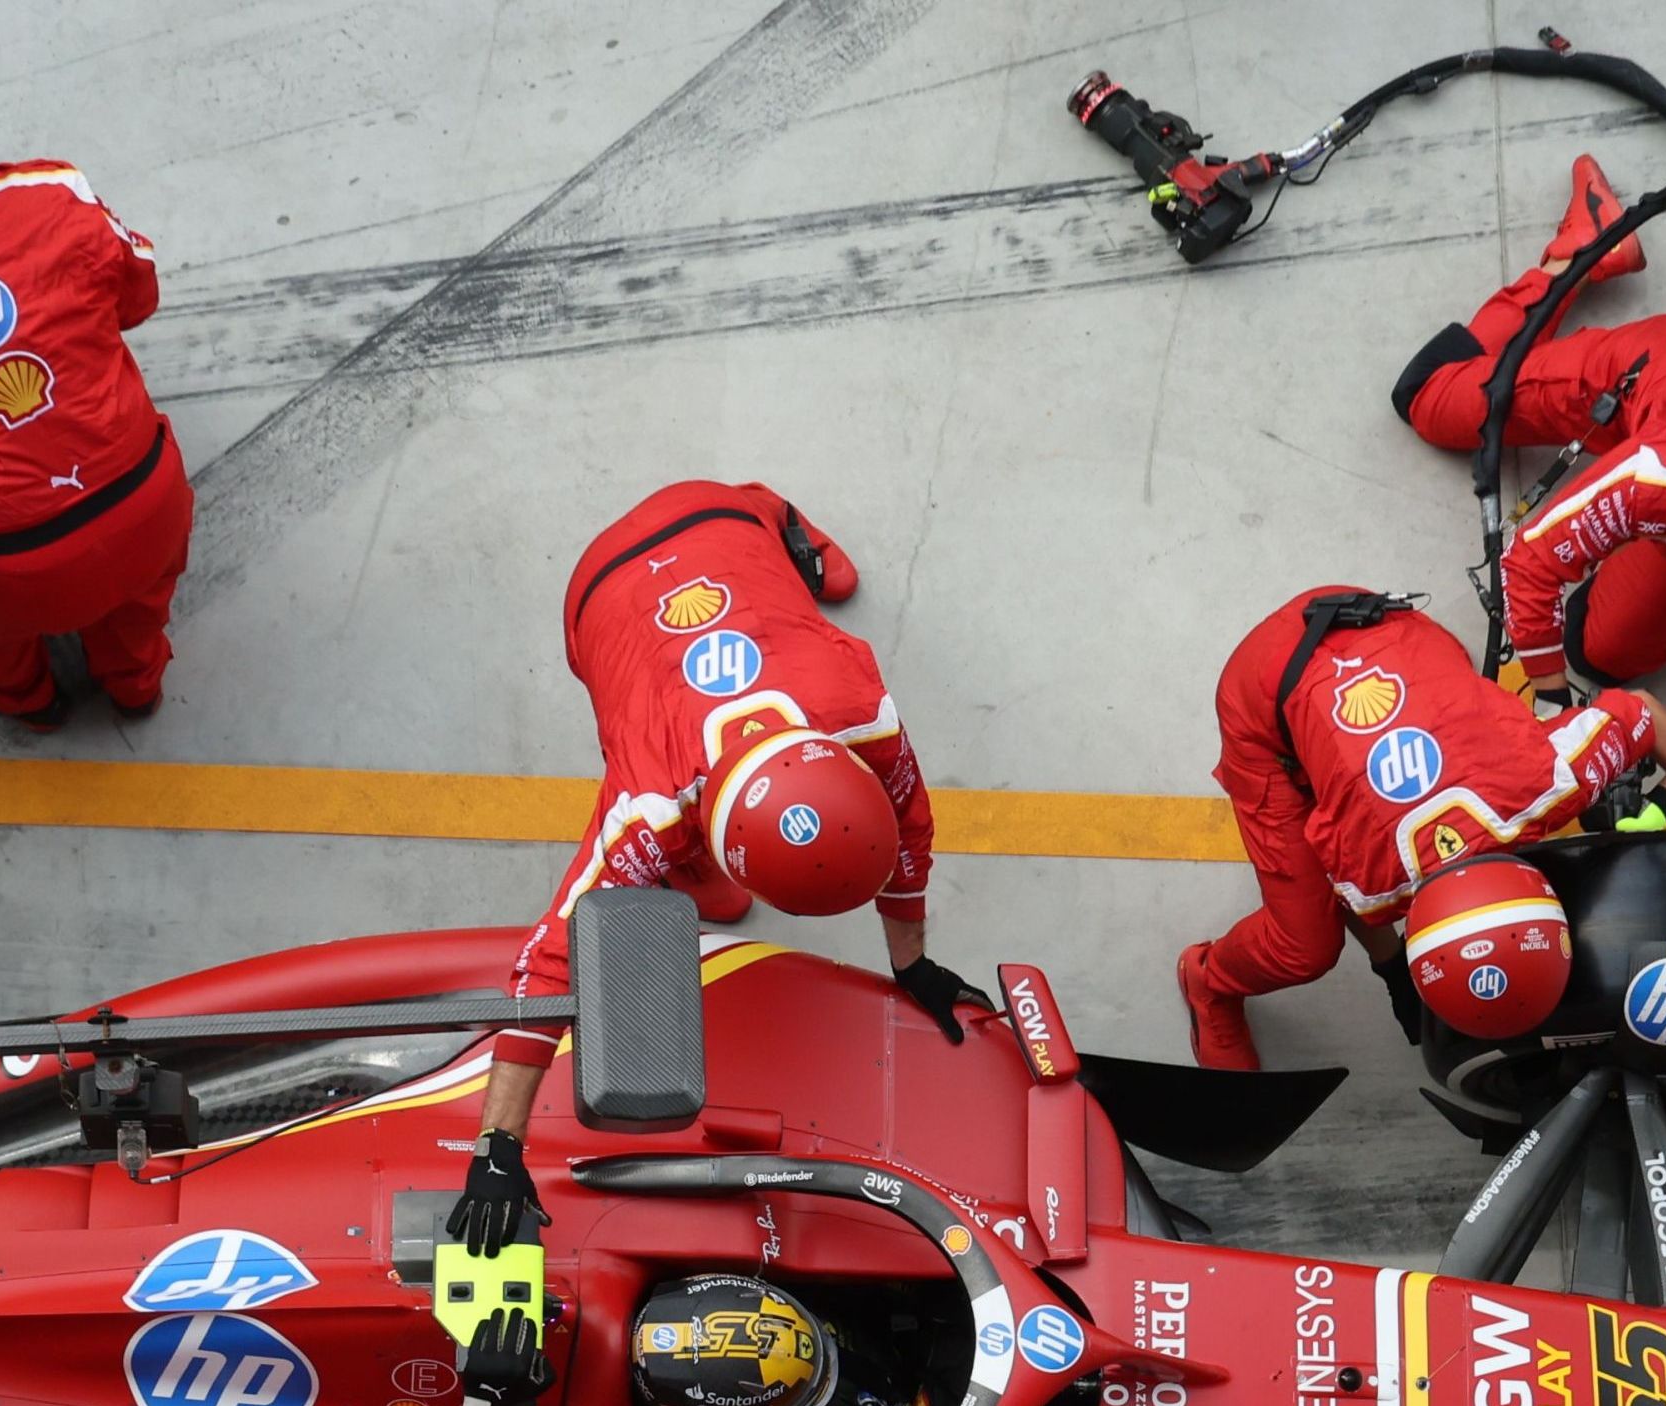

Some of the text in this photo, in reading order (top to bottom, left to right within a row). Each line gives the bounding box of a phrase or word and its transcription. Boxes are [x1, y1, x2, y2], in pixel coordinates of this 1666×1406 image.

[696, 632, 749, 693] hp
[1377, 729, 1434, 801] hp
[786, 806, 817, 842] hp
[1475, 967, 1501, 1000] hp
[1006, 978, 1056, 1079] VGW PLAY
[758, 1171, 813, 1183] Bitdefender
[863, 1172, 903, 1198] aws
[1465, 1130, 1541, 1224] #WeRaceAsOne
[757, 1204, 781, 1264] Ray-Ban
[980, 1325, 1014, 1355] hp
[1020, 1309, 1083, 1367] hp
[705, 1384, 785, 1406] Santander
